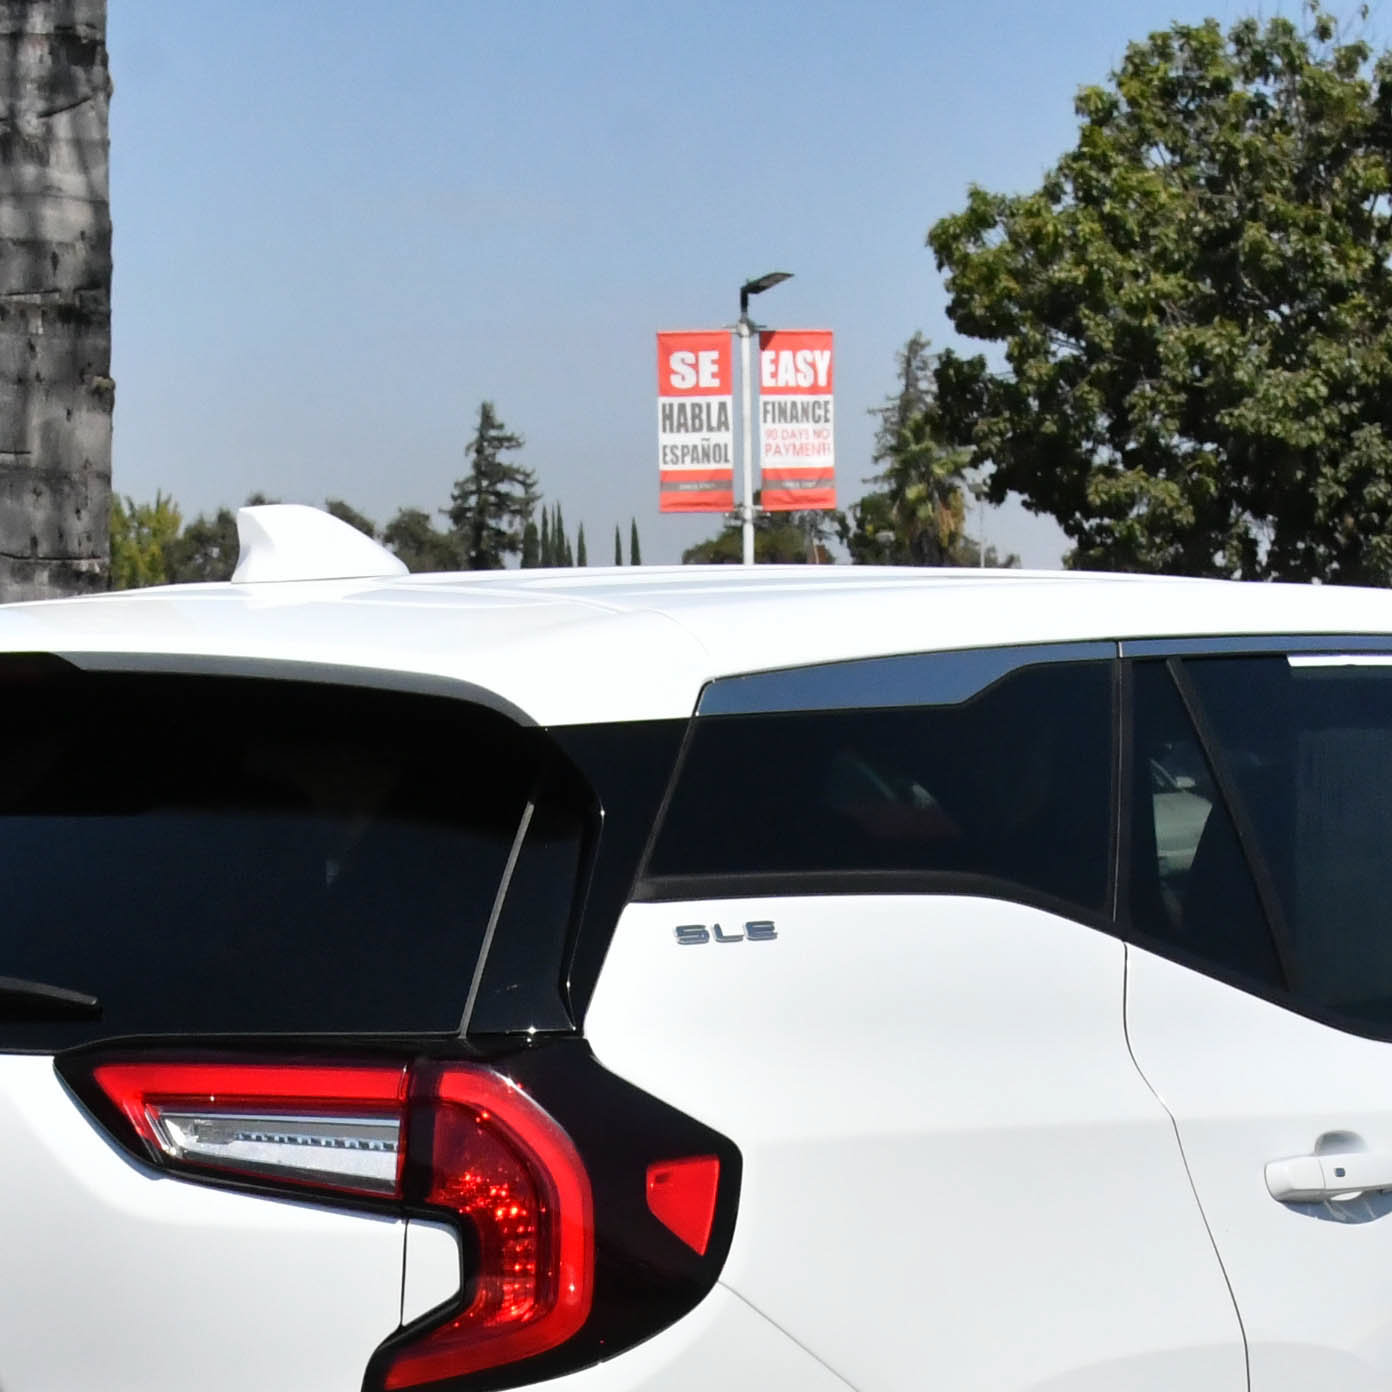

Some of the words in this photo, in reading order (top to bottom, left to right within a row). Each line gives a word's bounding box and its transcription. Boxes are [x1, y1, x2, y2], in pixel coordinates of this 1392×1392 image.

[669, 350, 721, 389] SE
[761, 350, 831, 388] EASY
[661, 401, 730, 433] HABLA
[762, 400, 831, 424] FINANCE
[662, 438, 730, 465] ESPAÑOL
[674, 920, 778, 945] SLE
